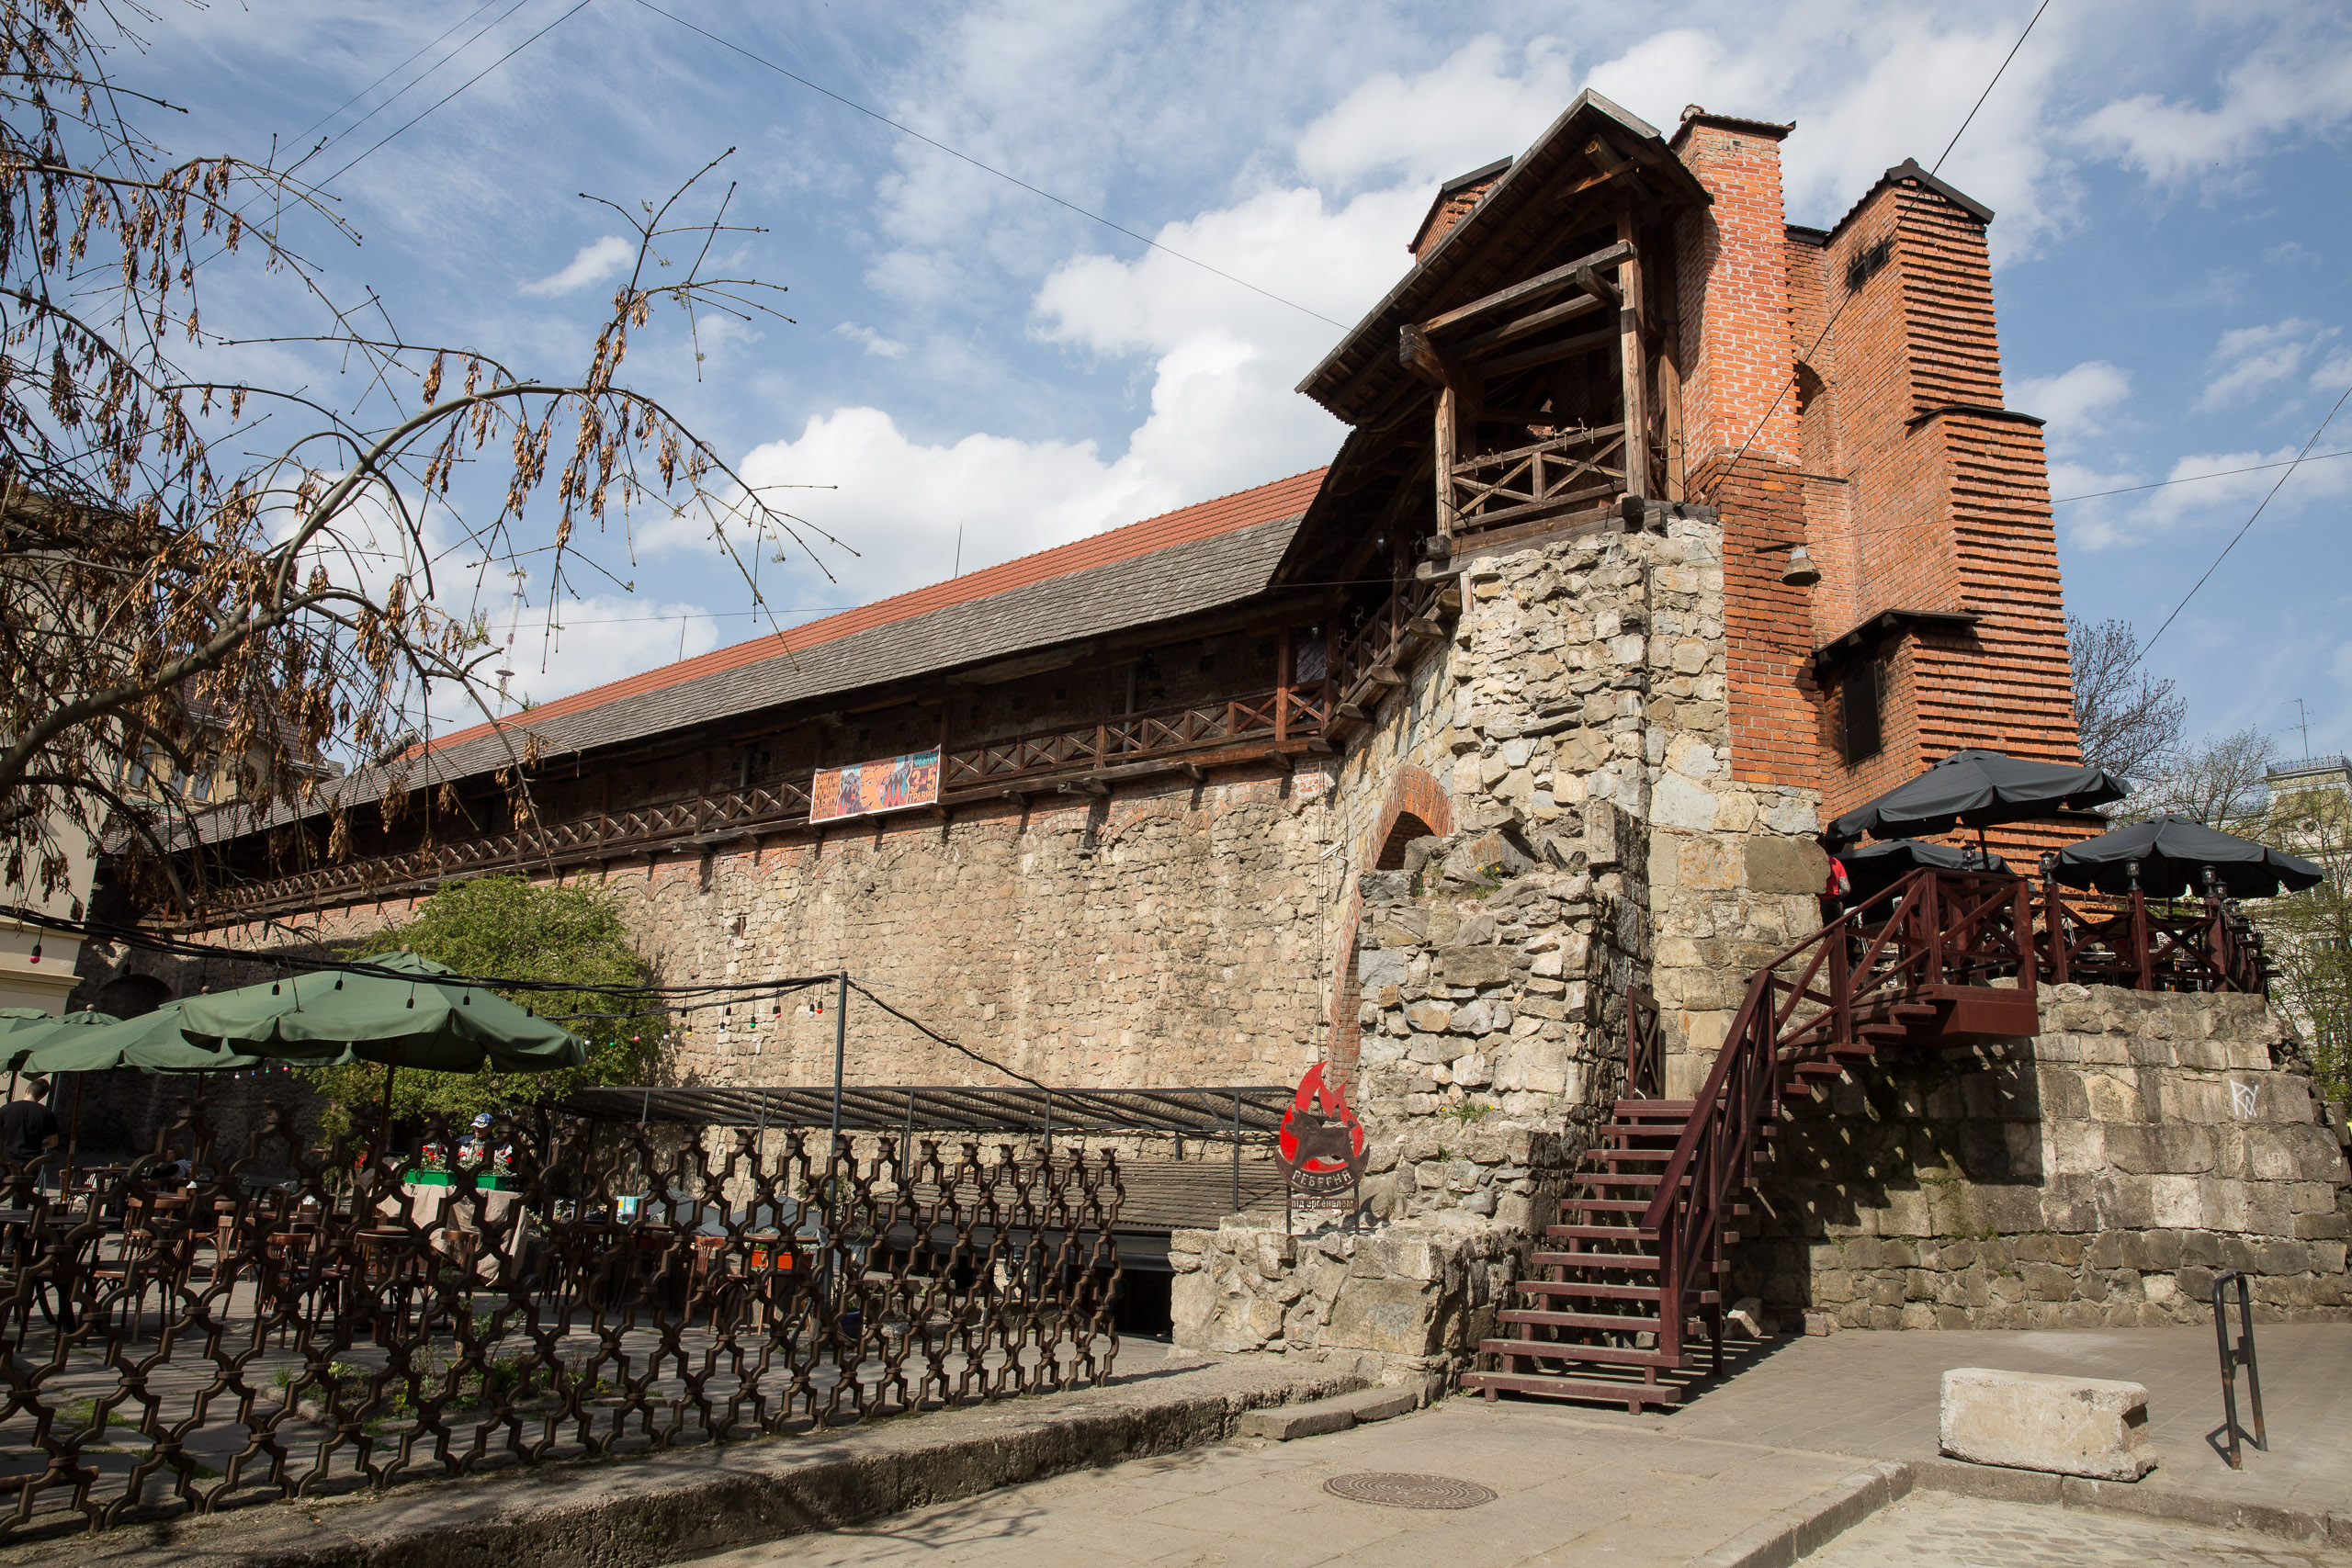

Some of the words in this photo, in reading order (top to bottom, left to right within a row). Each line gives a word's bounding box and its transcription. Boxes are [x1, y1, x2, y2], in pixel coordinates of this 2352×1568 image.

[909, 790, 935, 804] ТРАВНЯ
[1292, 1169, 1351, 1187] РЕБЕРНЯ
[1291, 1200, 1305, 1209] під
[1306, 1200, 1353, 1210] арсеналом
